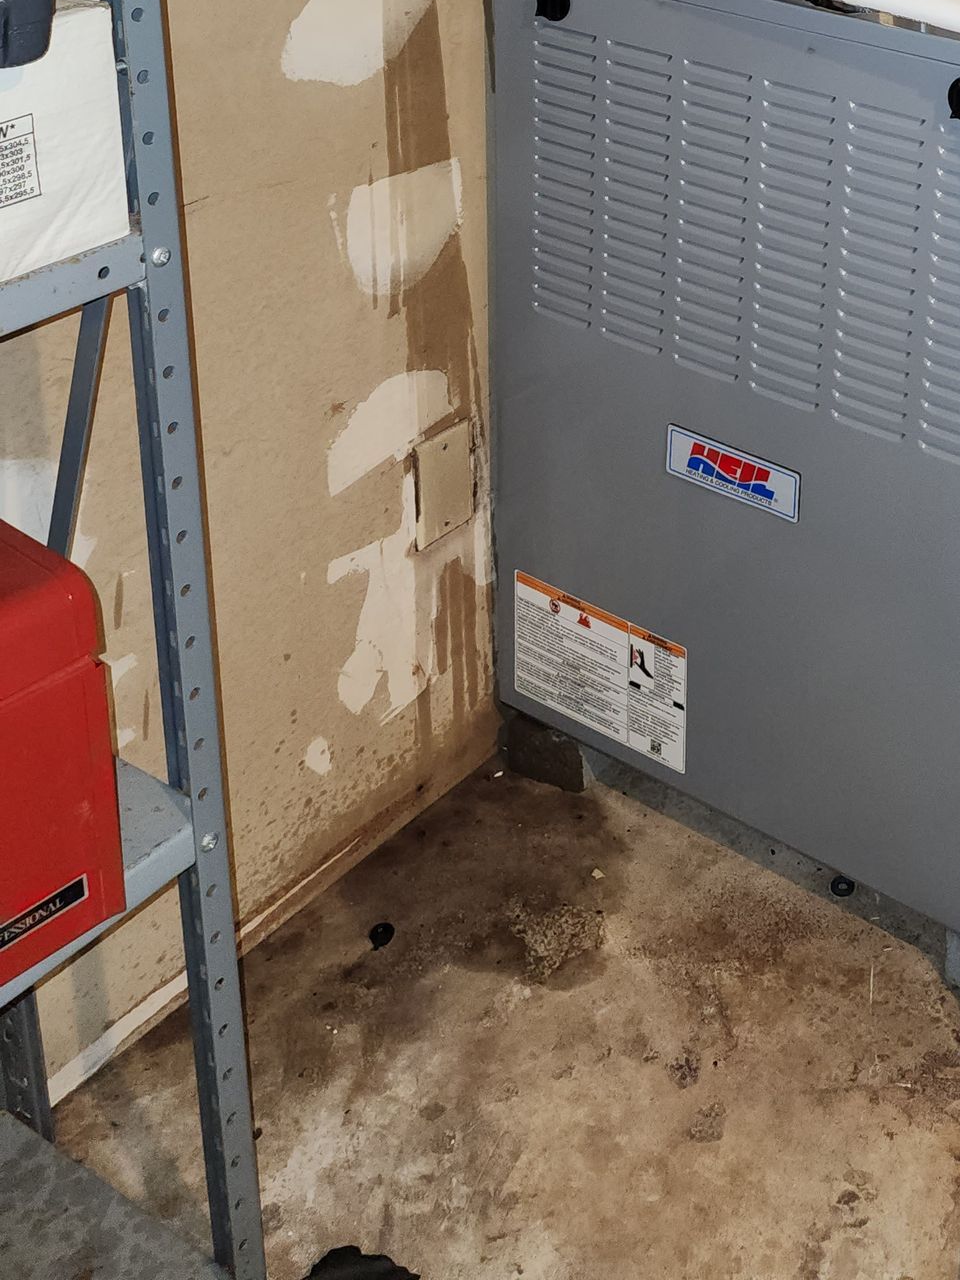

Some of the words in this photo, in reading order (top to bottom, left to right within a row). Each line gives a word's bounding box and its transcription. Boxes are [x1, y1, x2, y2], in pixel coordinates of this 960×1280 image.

[685, 468, 709, 482] HEATING
[714, 480, 740, 494] COOLING
[740, 490, 772, 506] PRODUCTS
[686, 441, 775, 501] HEIL
